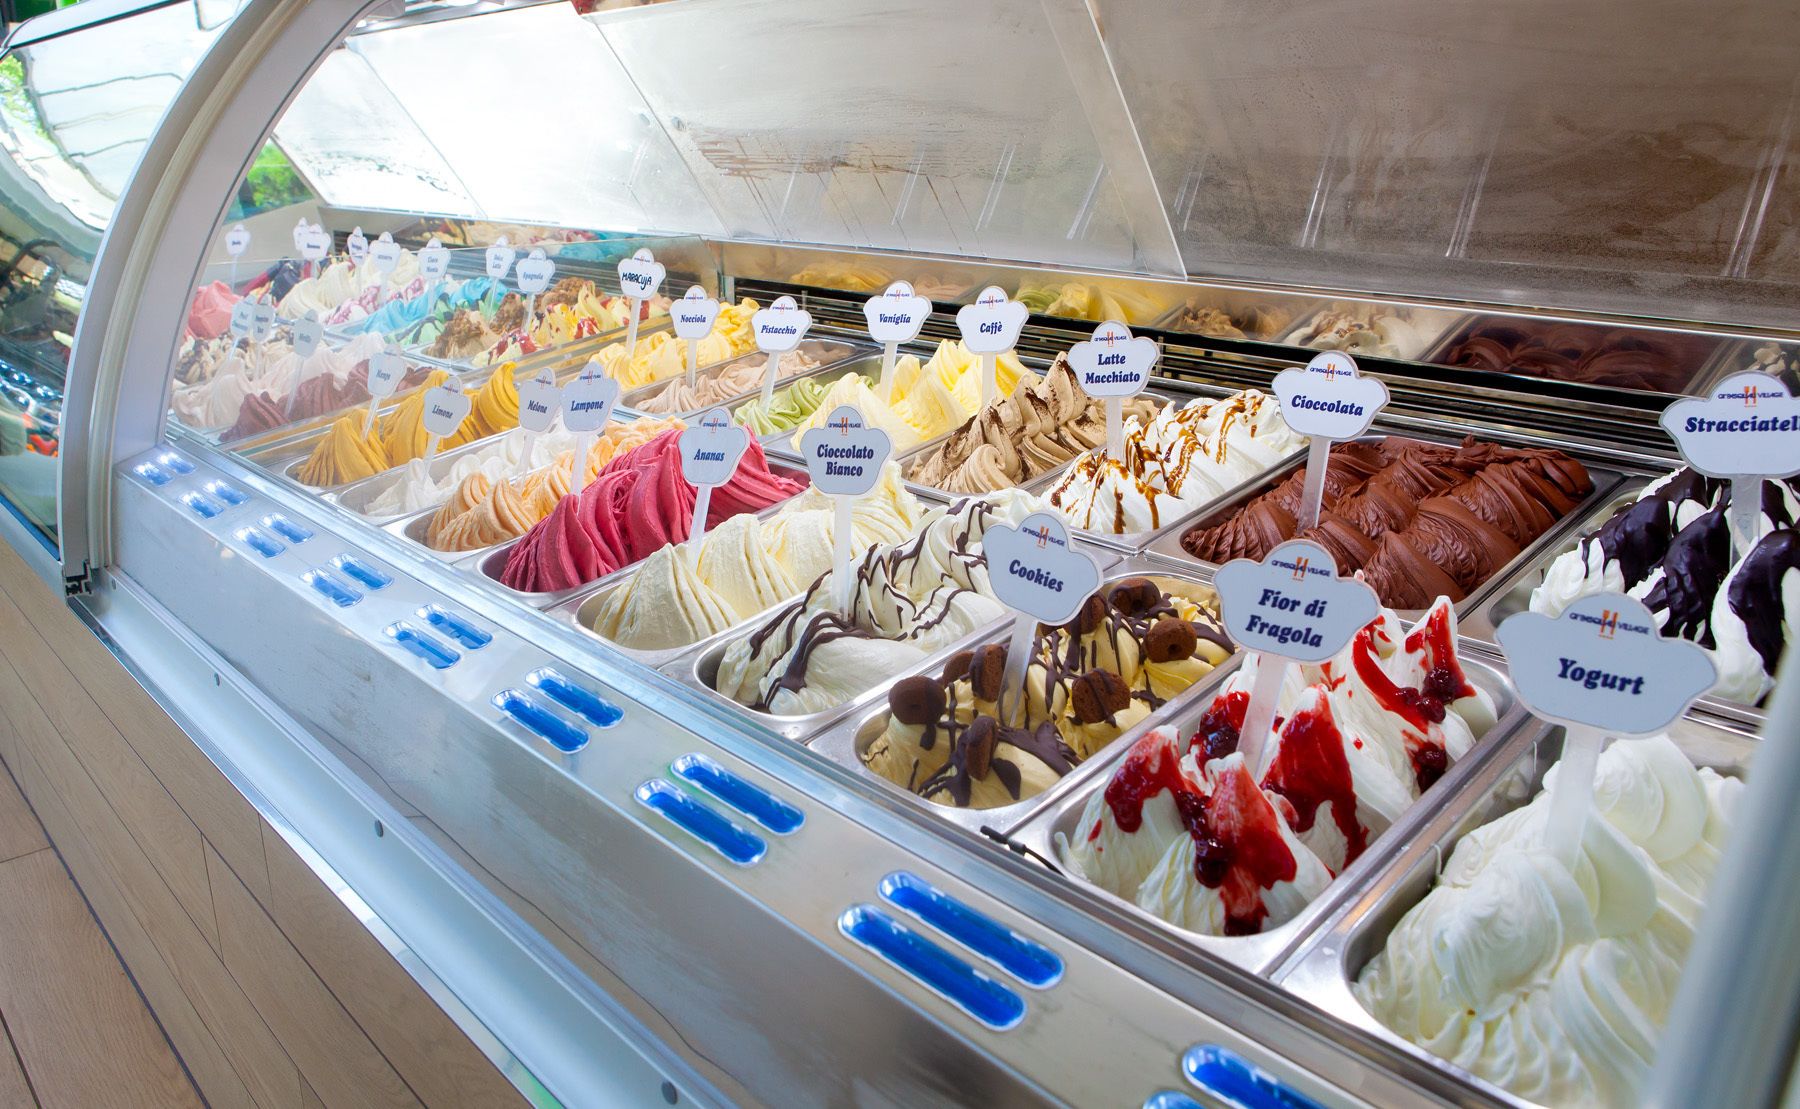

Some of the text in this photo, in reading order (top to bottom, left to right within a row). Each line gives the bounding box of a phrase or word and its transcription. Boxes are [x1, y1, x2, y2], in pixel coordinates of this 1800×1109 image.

[680, 314, 707, 323] Nocciola
[879, 313, 911, 325] Vaniglia
[760, 324, 797, 335] Pistacchio
[980, 321, 1003, 335] Caffè
[1097, 354, 1126, 366] Latte
[1085, 371, 1141, 384] Macchiato
[432, 404, 453, 419] Limone
[527, 399, 548, 414] Melone
[571, 400, 604, 413] Lampone
[1291, 394, 1364, 416] Cioccolata
[693, 448, 725, 461] Ananas
[817, 443, 874, 459] Cioccolato
[825, 461, 863, 477] Bianco
[1009, 559, 1064, 593] Cookies
[1258, 588, 1328, 618] Fior di
[1245, 614, 1323, 648] Fragola
[1558, 657, 1645, 695] Yogurt
